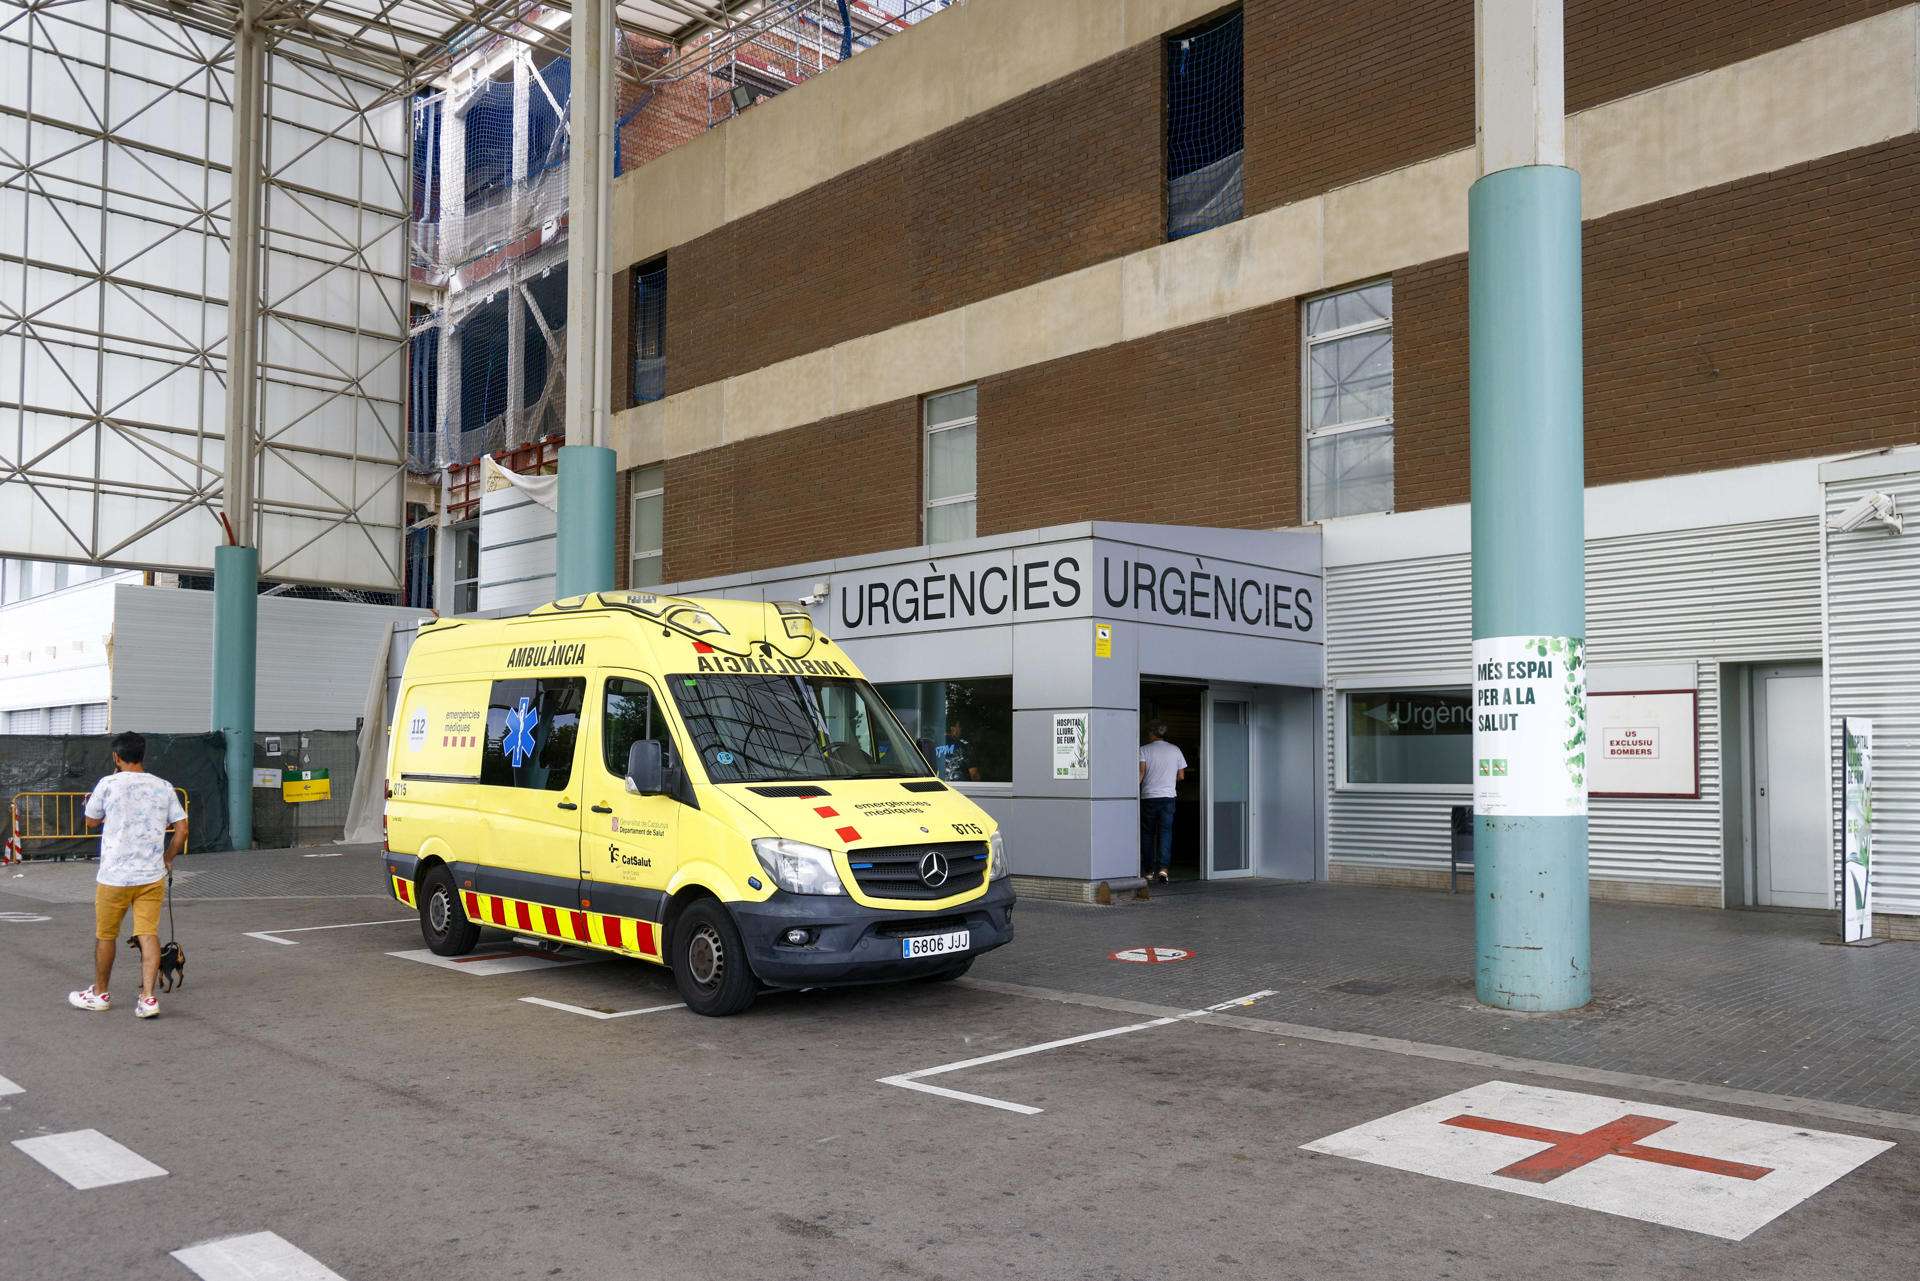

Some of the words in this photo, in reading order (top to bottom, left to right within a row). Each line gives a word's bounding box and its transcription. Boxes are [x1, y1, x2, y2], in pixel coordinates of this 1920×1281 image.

[842, 556, 1081, 629] URGÈNCIES
[1104, 556, 1313, 632] URGÈNCIES
[507, 639, 586, 668] AMBULÀNCIA
[1477, 657, 1503, 681] MÉS
[1507, 660, 1553, 679] ESPAI
[1478, 688, 1499, 706] PER
[1502, 687, 1512, 705] A
[1516, 687, 1536, 705] LA
[411, 719, 426, 734] 112
[1478, 713, 1519, 732] SALUT
[1625, 730, 1637, 738] US
[1609, 739, 1653, 747] EXCLUSIU
[1610, 748, 1652, 756] BOMBERS
[393, 783, 407, 796] 8715
[653, 829, 665, 837] Salut
[951, 823, 983, 835] 8715
[622, 855, 651, 867] CatSalut
[912, 937, 944, 955] 6806
[947, 933, 968, 950] JJJ
